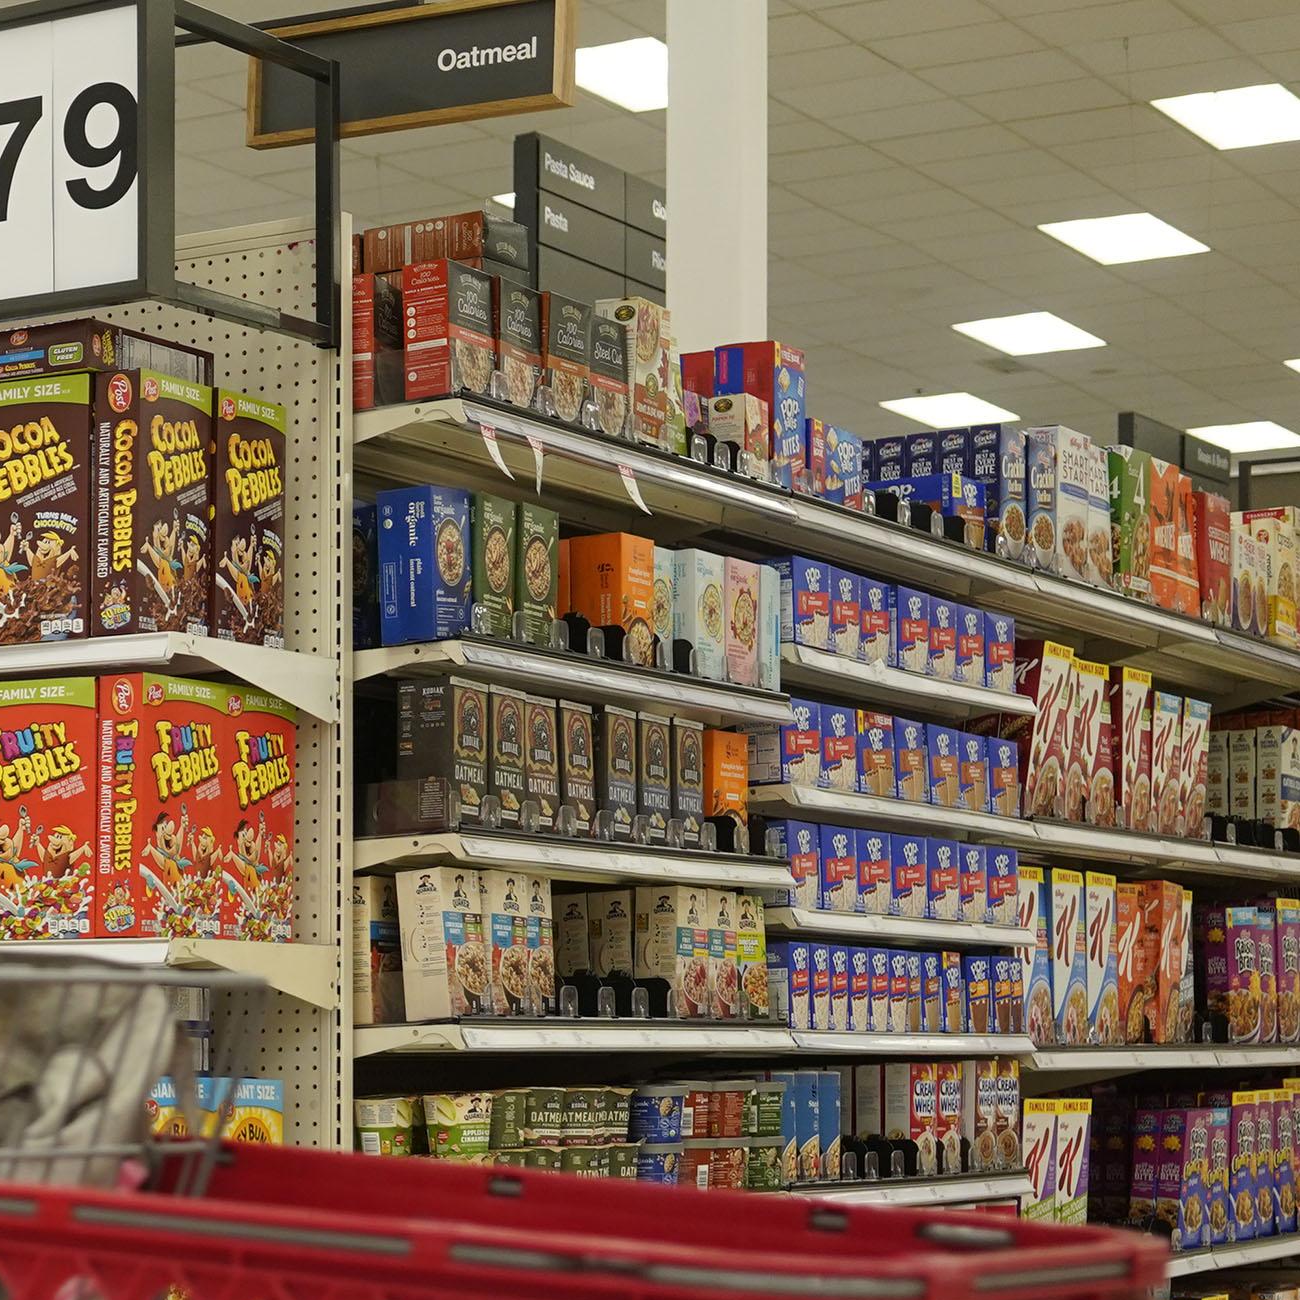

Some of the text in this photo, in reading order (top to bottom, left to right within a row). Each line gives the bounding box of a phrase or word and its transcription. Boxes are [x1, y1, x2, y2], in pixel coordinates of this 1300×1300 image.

[436, 36, 538, 72] Oatmeal
[544, 152, 595, 190] Pasta Sauce
[544, 205, 569, 232] Pasta
[457, 297, 488, 320] Calories
[54, 345, 79, 355] GLUTEN
[56, 352, 75, 361] FREE
[34, 382, 62, 398] SIZE
[113, 379, 130, 407] Post
[151, 415, 200, 453] COCOA
[228, 433, 276, 470] COCOA
[147, 450, 206, 499] PEBBLES
[96, 422, 110, 578] NATURALLY AND ARTIFICIALLY FLAVORED
[112, 419, 138, 572] COCOA PEBBLES
[226, 467, 283, 516] PEBBLES
[39, 685, 66, 698] SIZE
[116, 683, 131, 709] Post
[151, 745, 220, 802] PEBBLES
[232, 754, 291, 811] PEBBLES
[455, 765, 485, 785] OATMEAL
[494, 771, 524, 790] OATMEAL
[528, 778, 558, 796] OATMEAL
[99, 720, 113, 874] NATURALLY AND ARTIFICIALLY FLAVORED
[113, 798, 138, 871] PEBBLES
[256, 1086, 276, 1100] SIZE
